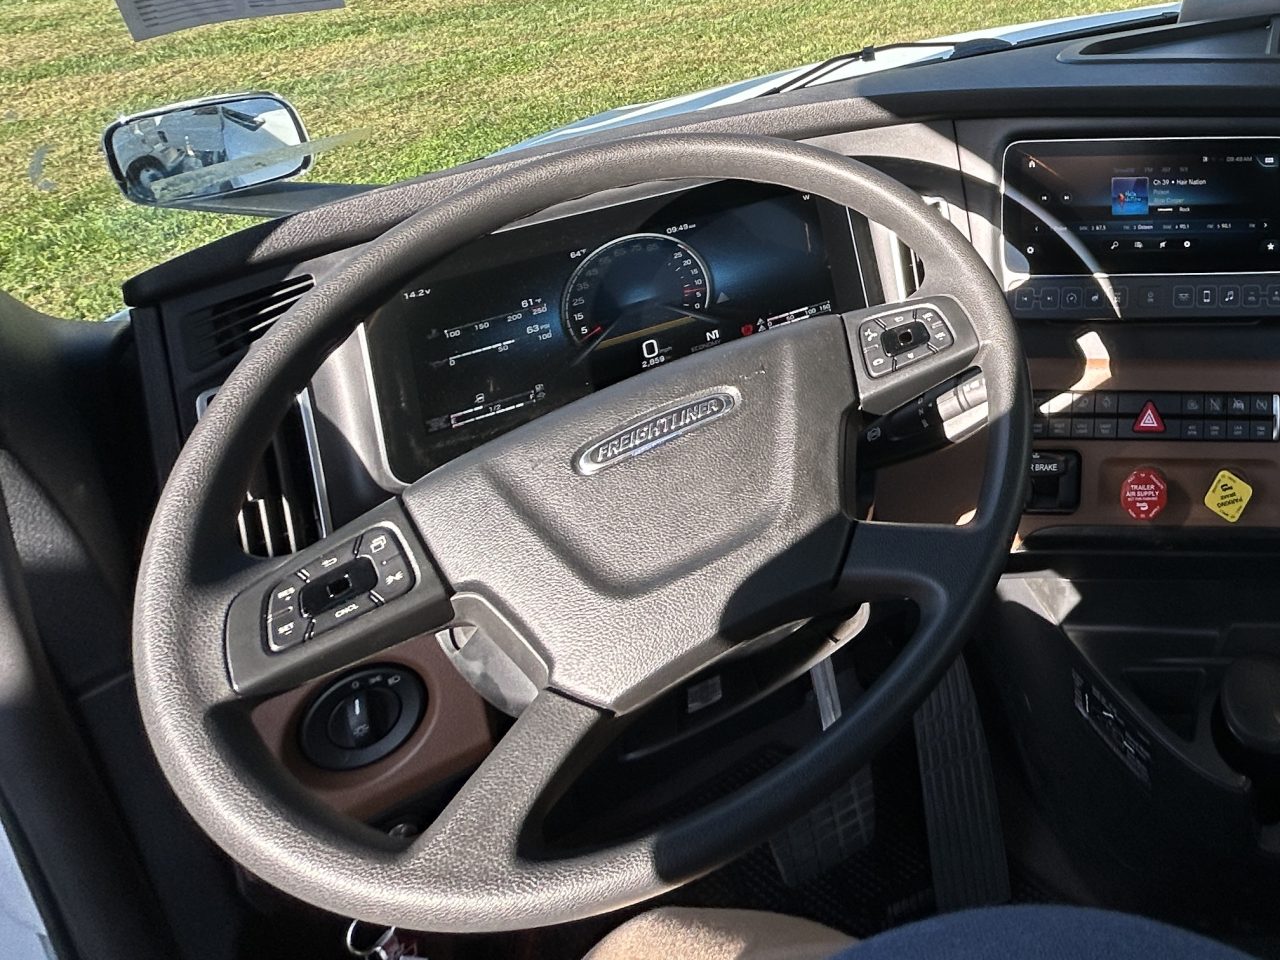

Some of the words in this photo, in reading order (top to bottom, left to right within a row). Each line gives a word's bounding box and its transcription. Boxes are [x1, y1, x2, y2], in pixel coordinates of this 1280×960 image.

[673, 251, 683, 259] 25
[572, 297, 585, 306] 25
[573, 312, 584, 321] 15
[445, 330, 461, 338] 100
[474, 322, 490, 331] 150
[507, 313, 522, 322] 200
[581, 326, 588, 335] 5
[641, 339, 659, 358] 0
[690, 340, 721, 353] ECONOMY
[597, 399, 719, 462] FREIGHTLINER
[1035, 463, 1058, 471] BRAKE
[334, 604, 359, 618] CNCL
